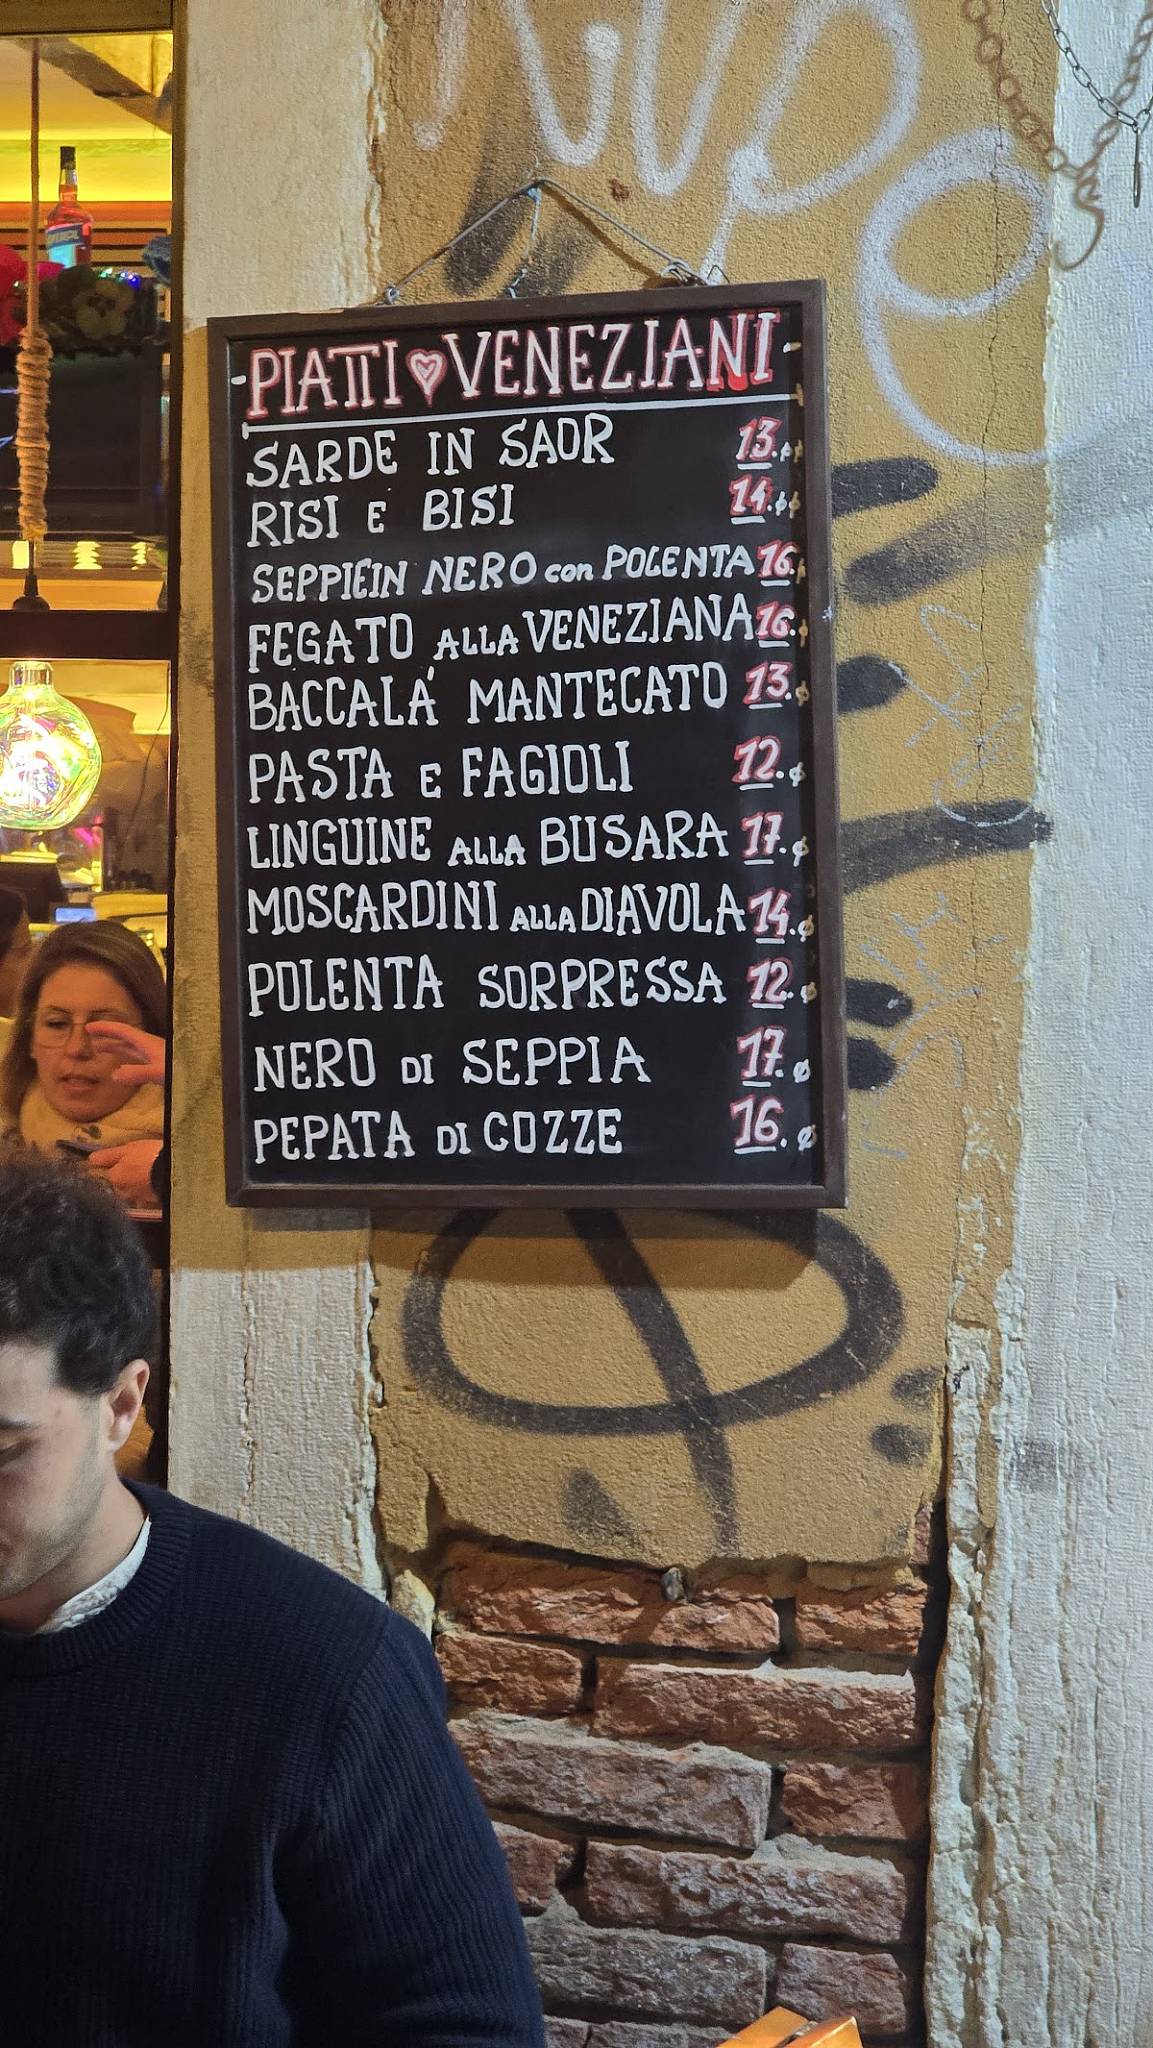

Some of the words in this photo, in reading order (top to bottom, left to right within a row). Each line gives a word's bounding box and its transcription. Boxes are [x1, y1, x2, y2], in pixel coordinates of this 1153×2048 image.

[246, 340, 402, 419] PIATTI
[441, 307, 781, 397] VENEZIANI
[247, 430, 398, 488] SARDE
[427, 428, 474, 475] IN
[499, 412, 615, 468] SAOR
[247, 495, 339, 547] RISI
[368, 501, 386, 533] E
[423, 484, 514, 531] BISI
[422, 552, 537, 595] NERO
[602, 544, 755, 580] POLENTA
[249, 613, 413, 673] FEGATO
[433, 625, 519, 660] ALLA
[522, 593, 753, 652] VENEZIANA
[467, 662, 727, 724] MANTECATO
[249, 746, 393, 803] PASTA
[420, 763, 441, 798] E
[463, 741, 633, 797] FAGIOLI
[247, 817, 431, 868] LINGUINE
[448, 835, 526, 866] ALLA
[541, 810, 729, 865] BUSARA
[248, 880, 499, 935] MOSCARDINI
[510, 904, 576, 933] ALLA
[582, 883, 746, 936] DIAVOLA
[248, 954, 444, 1017] POLENTA
[479, 956, 726, 1011] SORPRESSA
[254, 1038, 375, 1091] NERO
[401, 1054, 434, 1084] DI
[463, 1036, 651, 1085] SEPPIA
[255, 1111, 415, 1164] PEPATA
[437, 1123, 471, 1154] DI
[484, 1108, 622, 1154] COZZE
